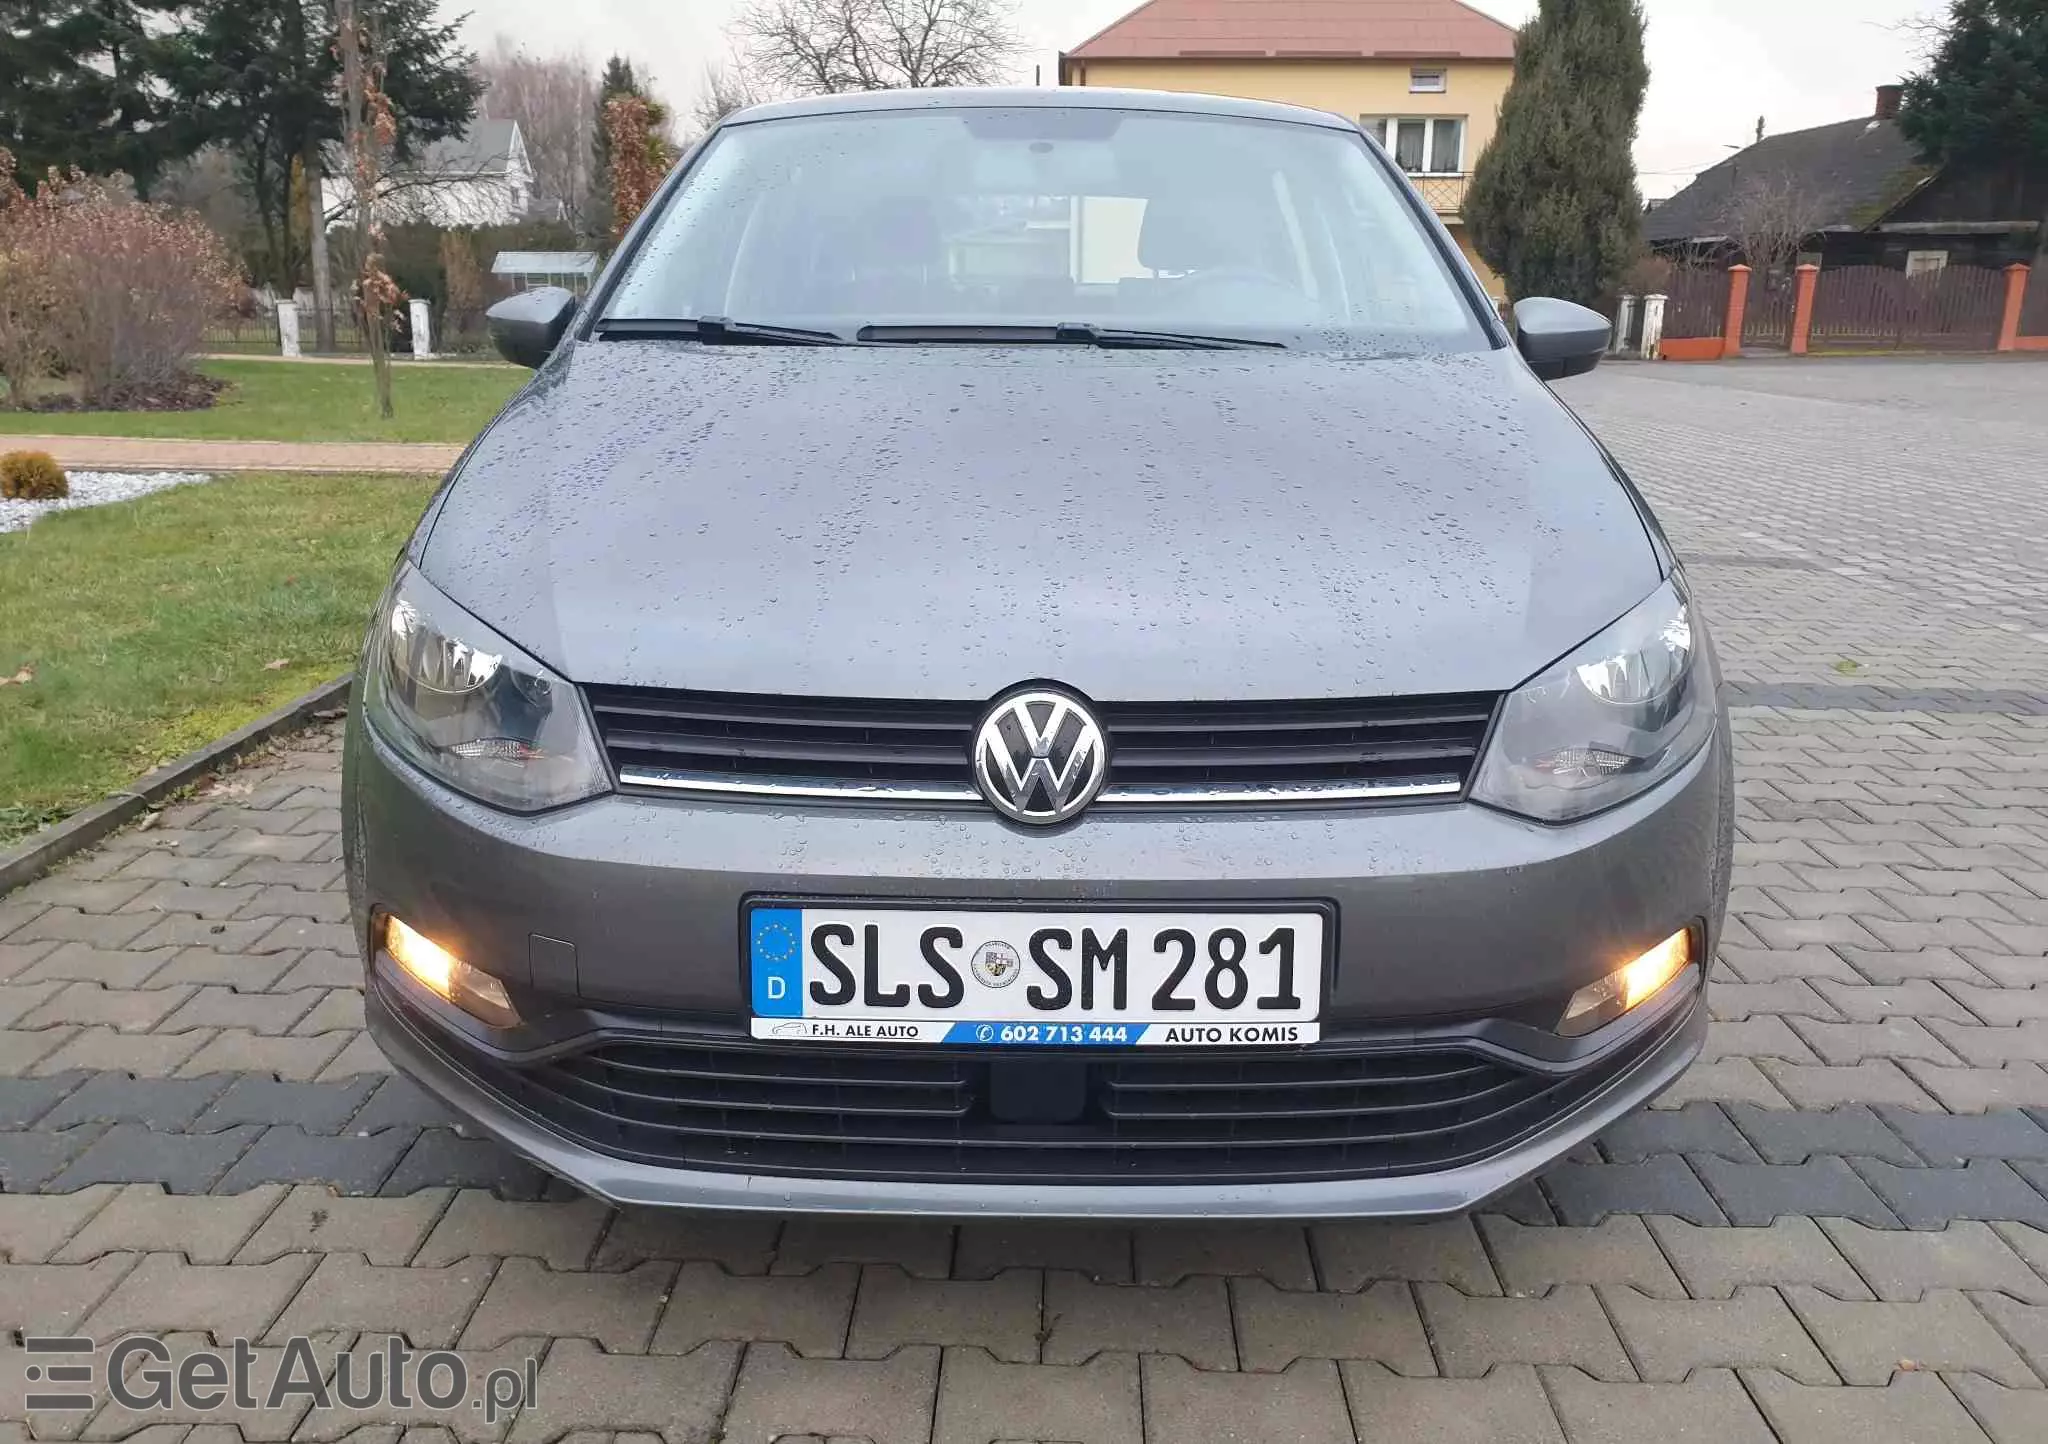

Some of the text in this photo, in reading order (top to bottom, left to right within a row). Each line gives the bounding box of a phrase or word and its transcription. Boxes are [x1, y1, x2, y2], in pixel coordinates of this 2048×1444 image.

[809, 923, 1301, 1011] SLS SM 281
[767, 976, 786, 1000] D
[812, 1024, 919, 1038] F.H. ALE AUTO
[1000, 1025, 1128, 1042] 602 713 444
[1165, 1026, 1298, 1043] AUTO KOMIS
